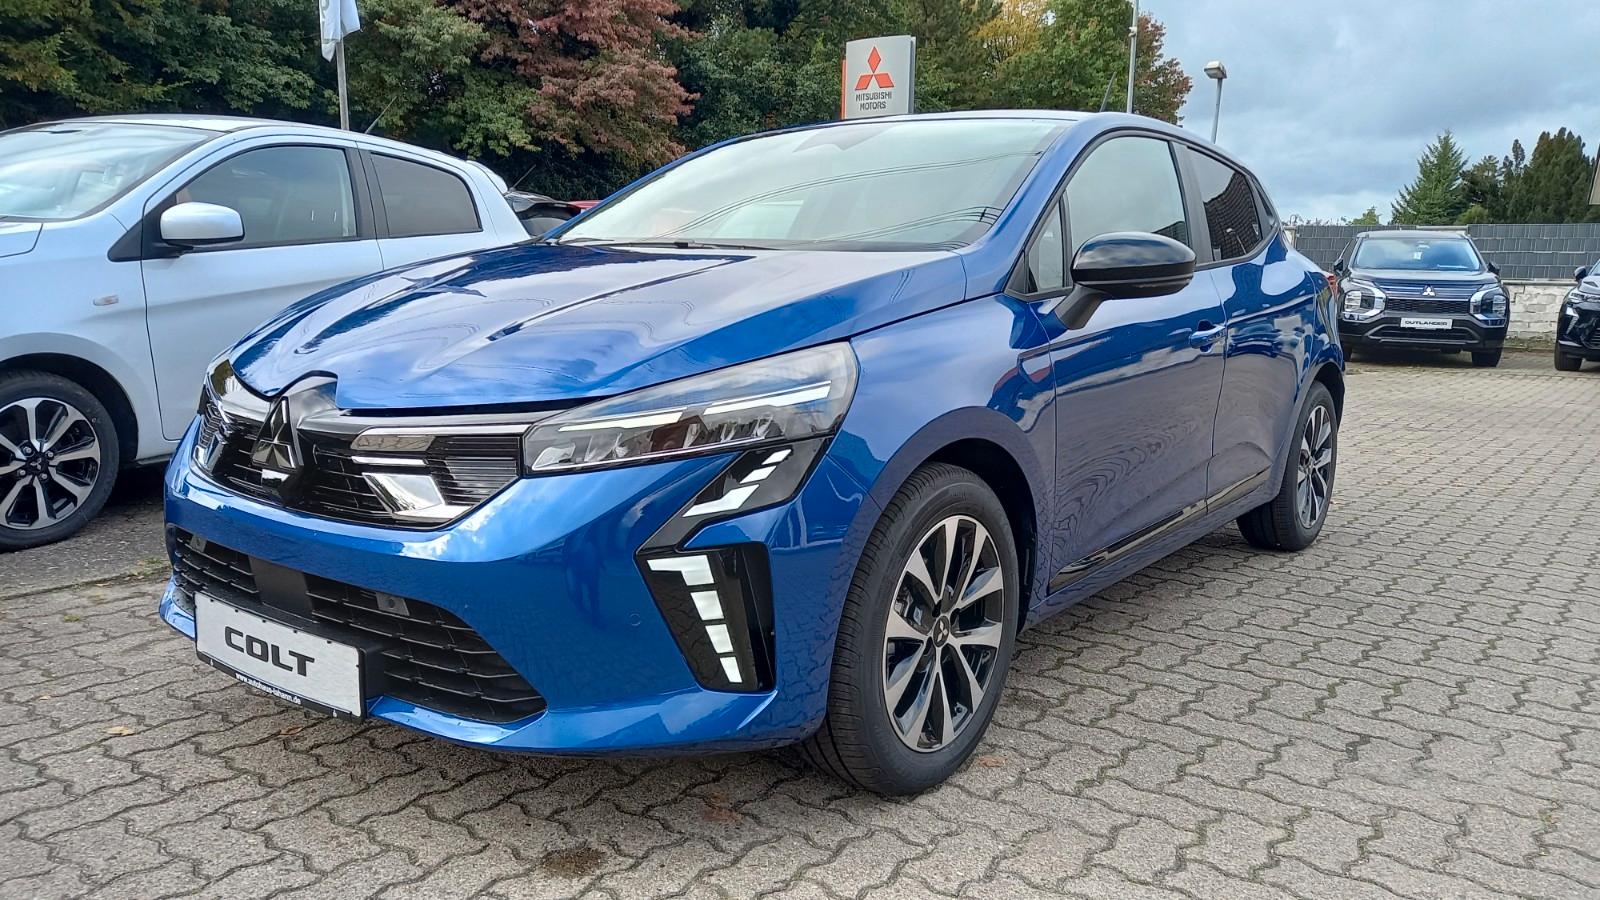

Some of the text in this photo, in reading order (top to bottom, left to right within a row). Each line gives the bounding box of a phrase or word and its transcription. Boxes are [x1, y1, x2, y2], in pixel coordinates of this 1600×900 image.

[856, 91, 893, 102] MITSUBISHI
[860, 101, 887, 111] MOTORS
[225, 626, 315, 677] COLT
